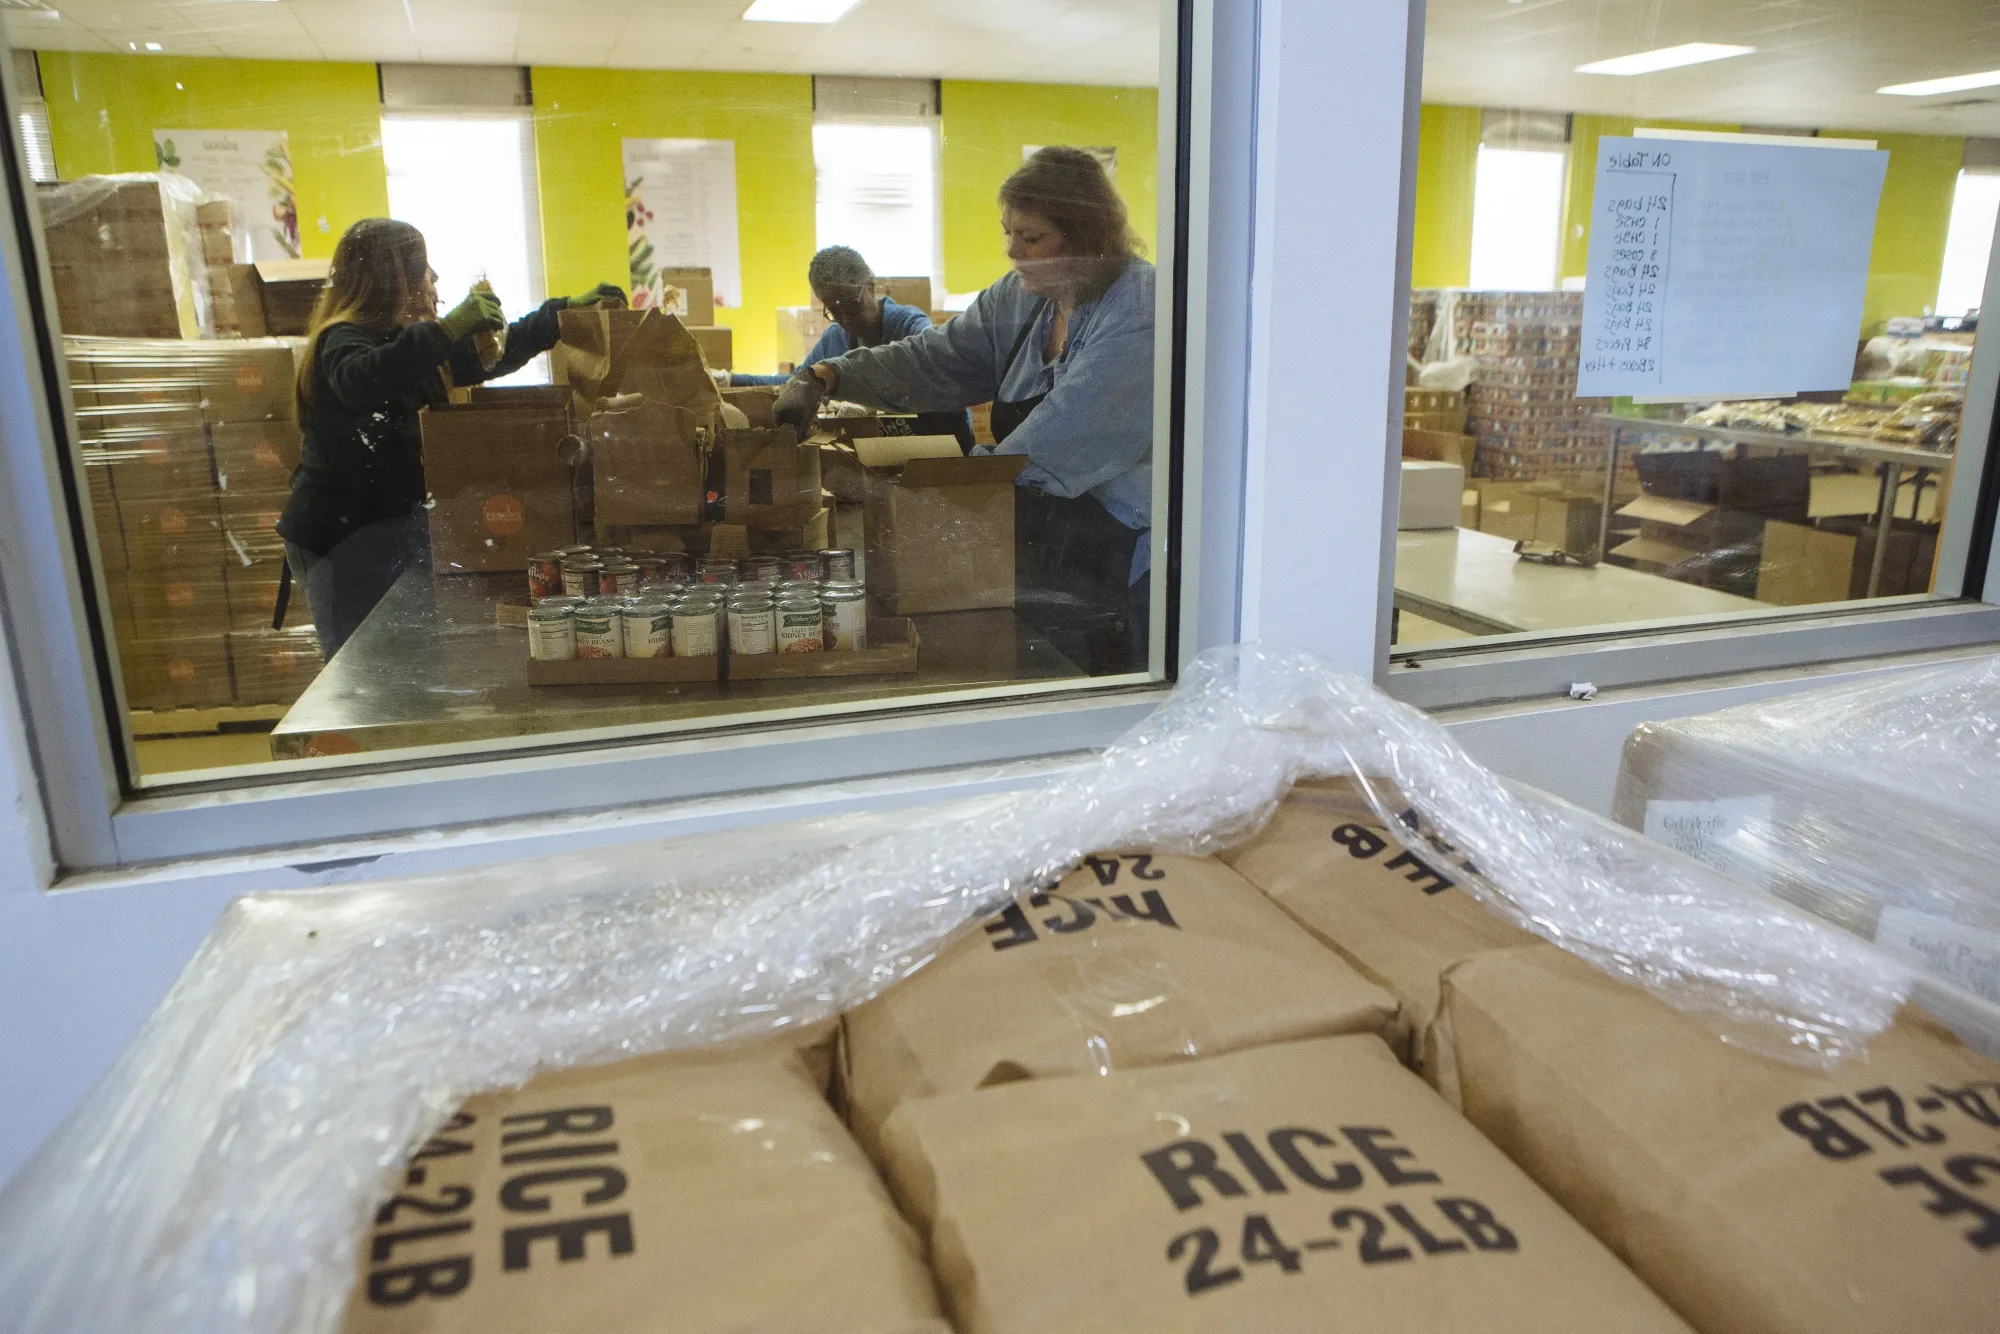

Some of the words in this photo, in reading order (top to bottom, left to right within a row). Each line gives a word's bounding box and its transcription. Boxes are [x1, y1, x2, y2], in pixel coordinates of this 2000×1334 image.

[500, 1105, 635, 1273] RICE
[1139, 1126, 1442, 1214] RICE
[1166, 1196, 1520, 1298] 24-2LB
